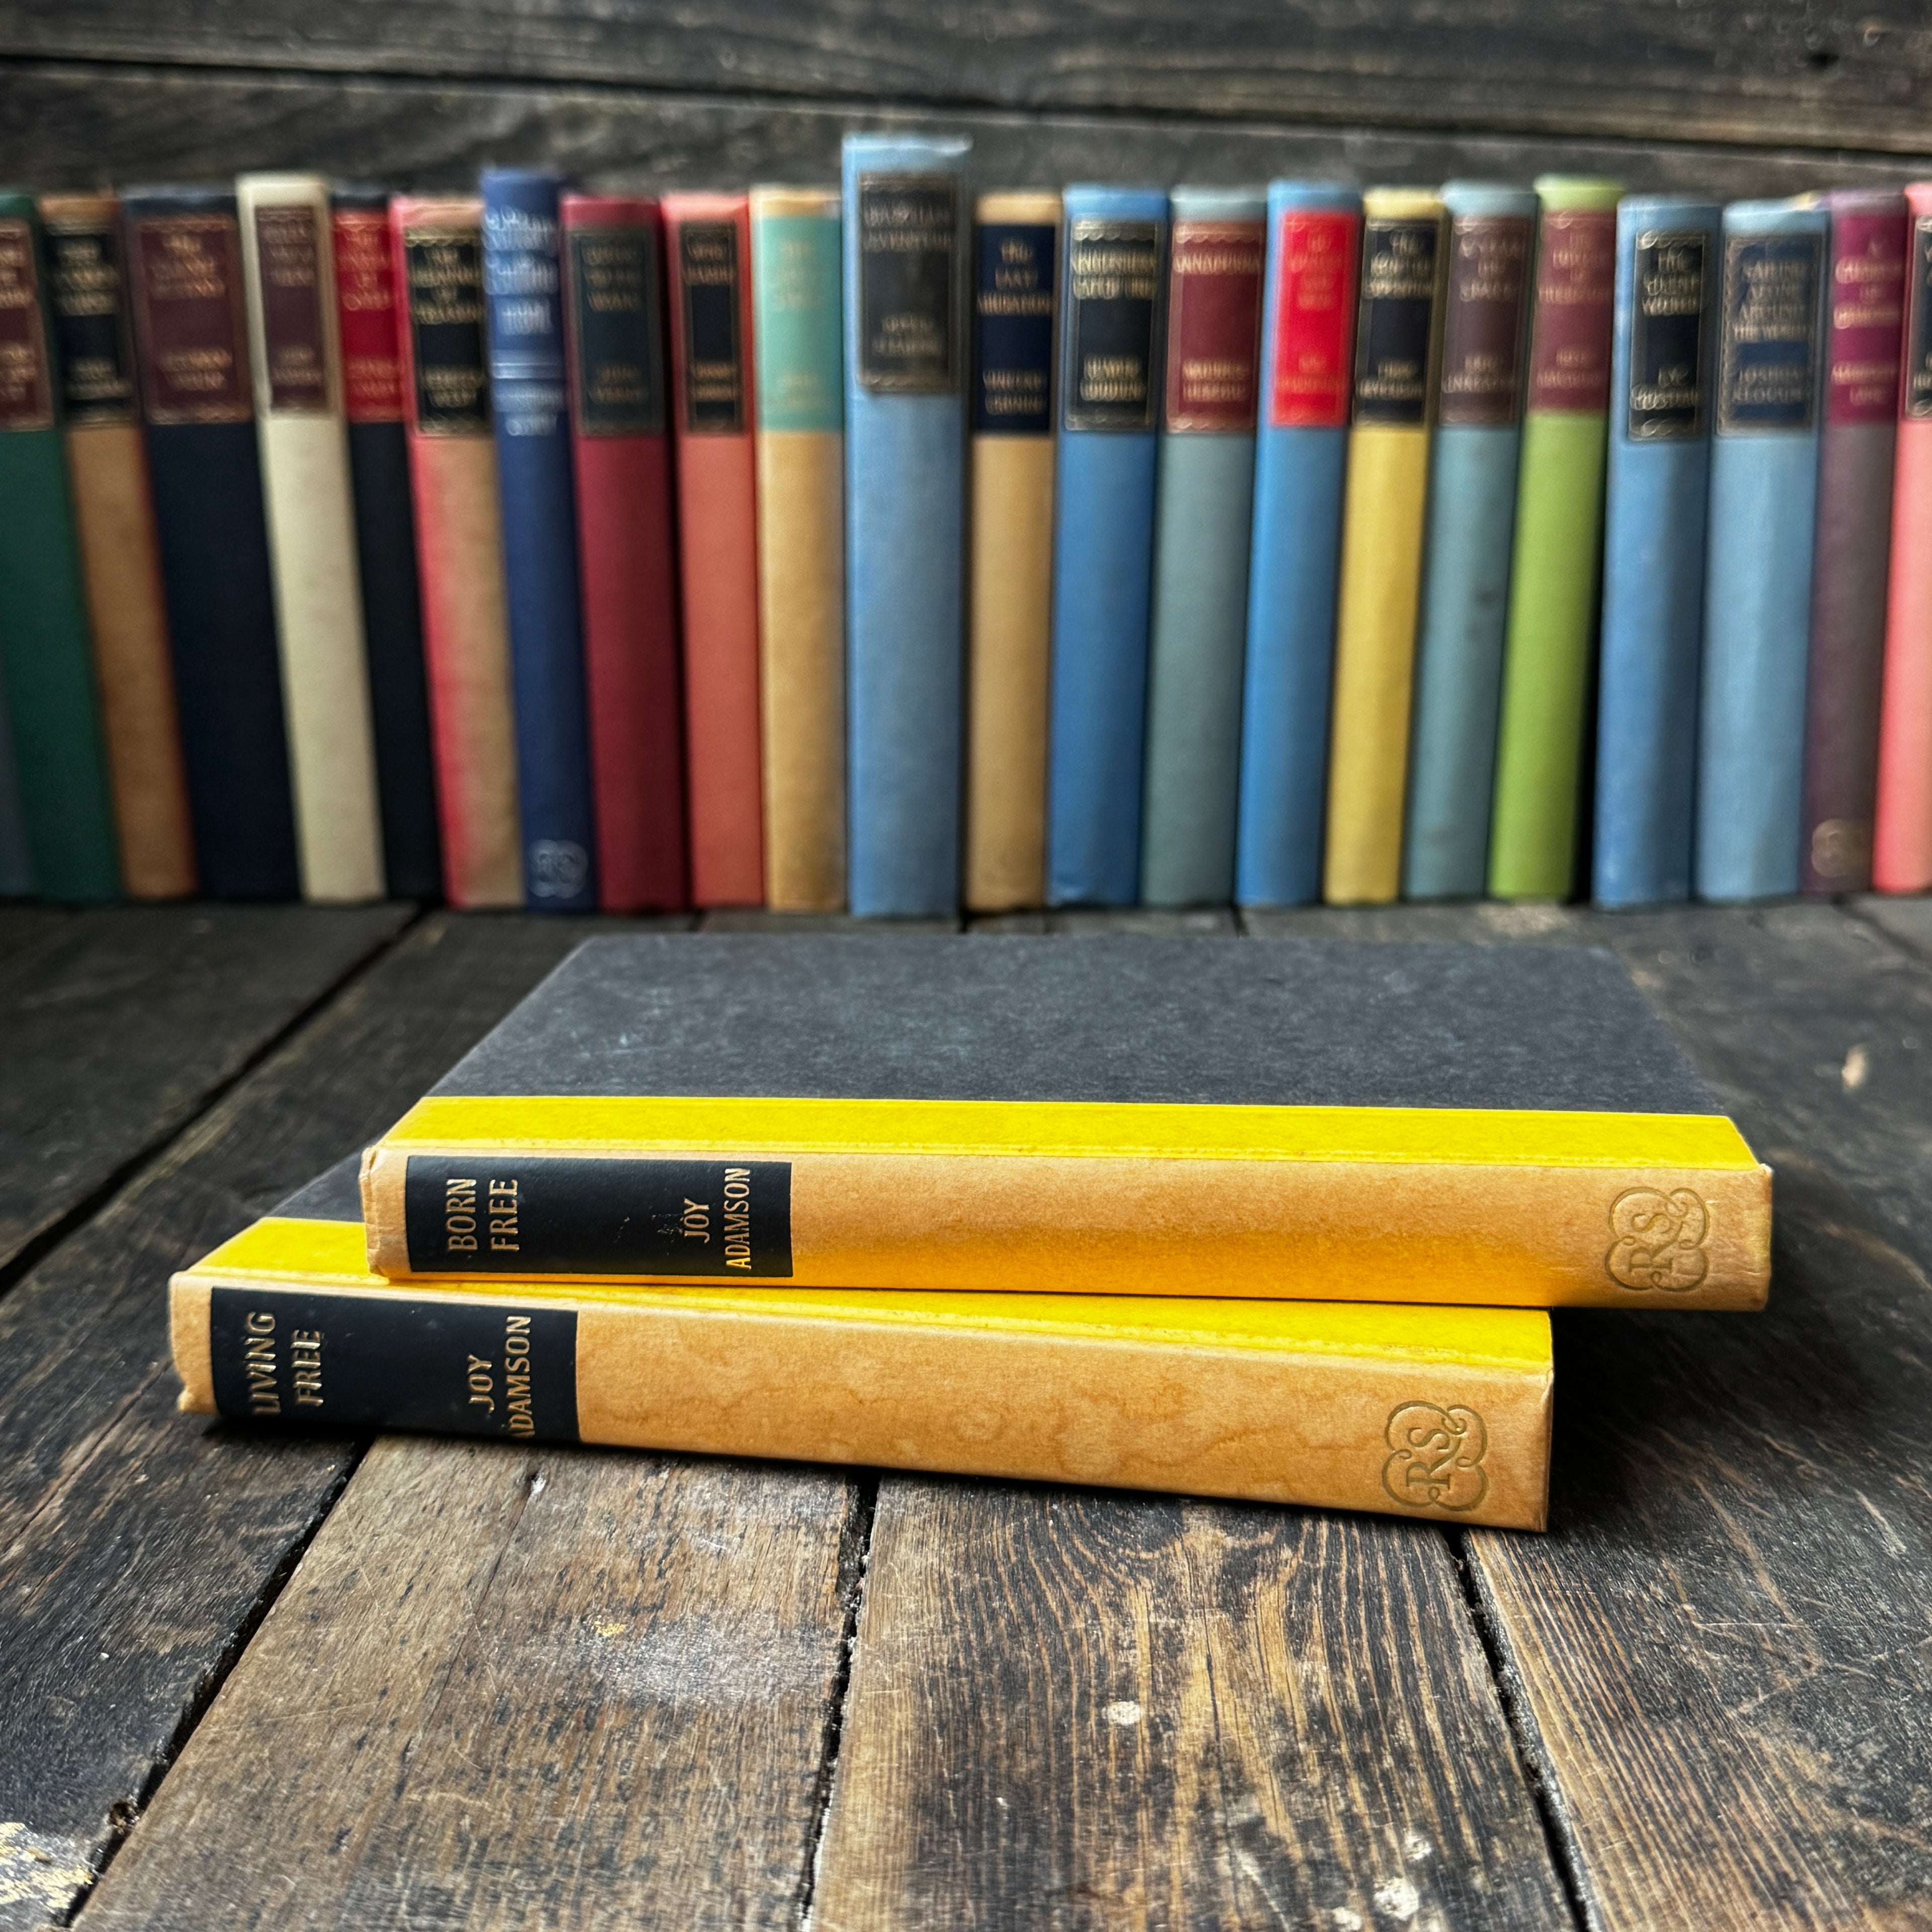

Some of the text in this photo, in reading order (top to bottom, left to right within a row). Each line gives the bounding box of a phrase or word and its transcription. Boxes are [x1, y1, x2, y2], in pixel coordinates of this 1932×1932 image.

[446, 1178, 478, 1251] BORN
[489, 1179, 520, 1251] FREE
[683, 1197, 710, 1244] JOY
[723, 1167, 752, 1271] ADAMSON
[244, 1311, 281, 1415] LIVING
[291, 1329, 324, 1407] FREE
[468, 1354, 494, 1414] JOY
